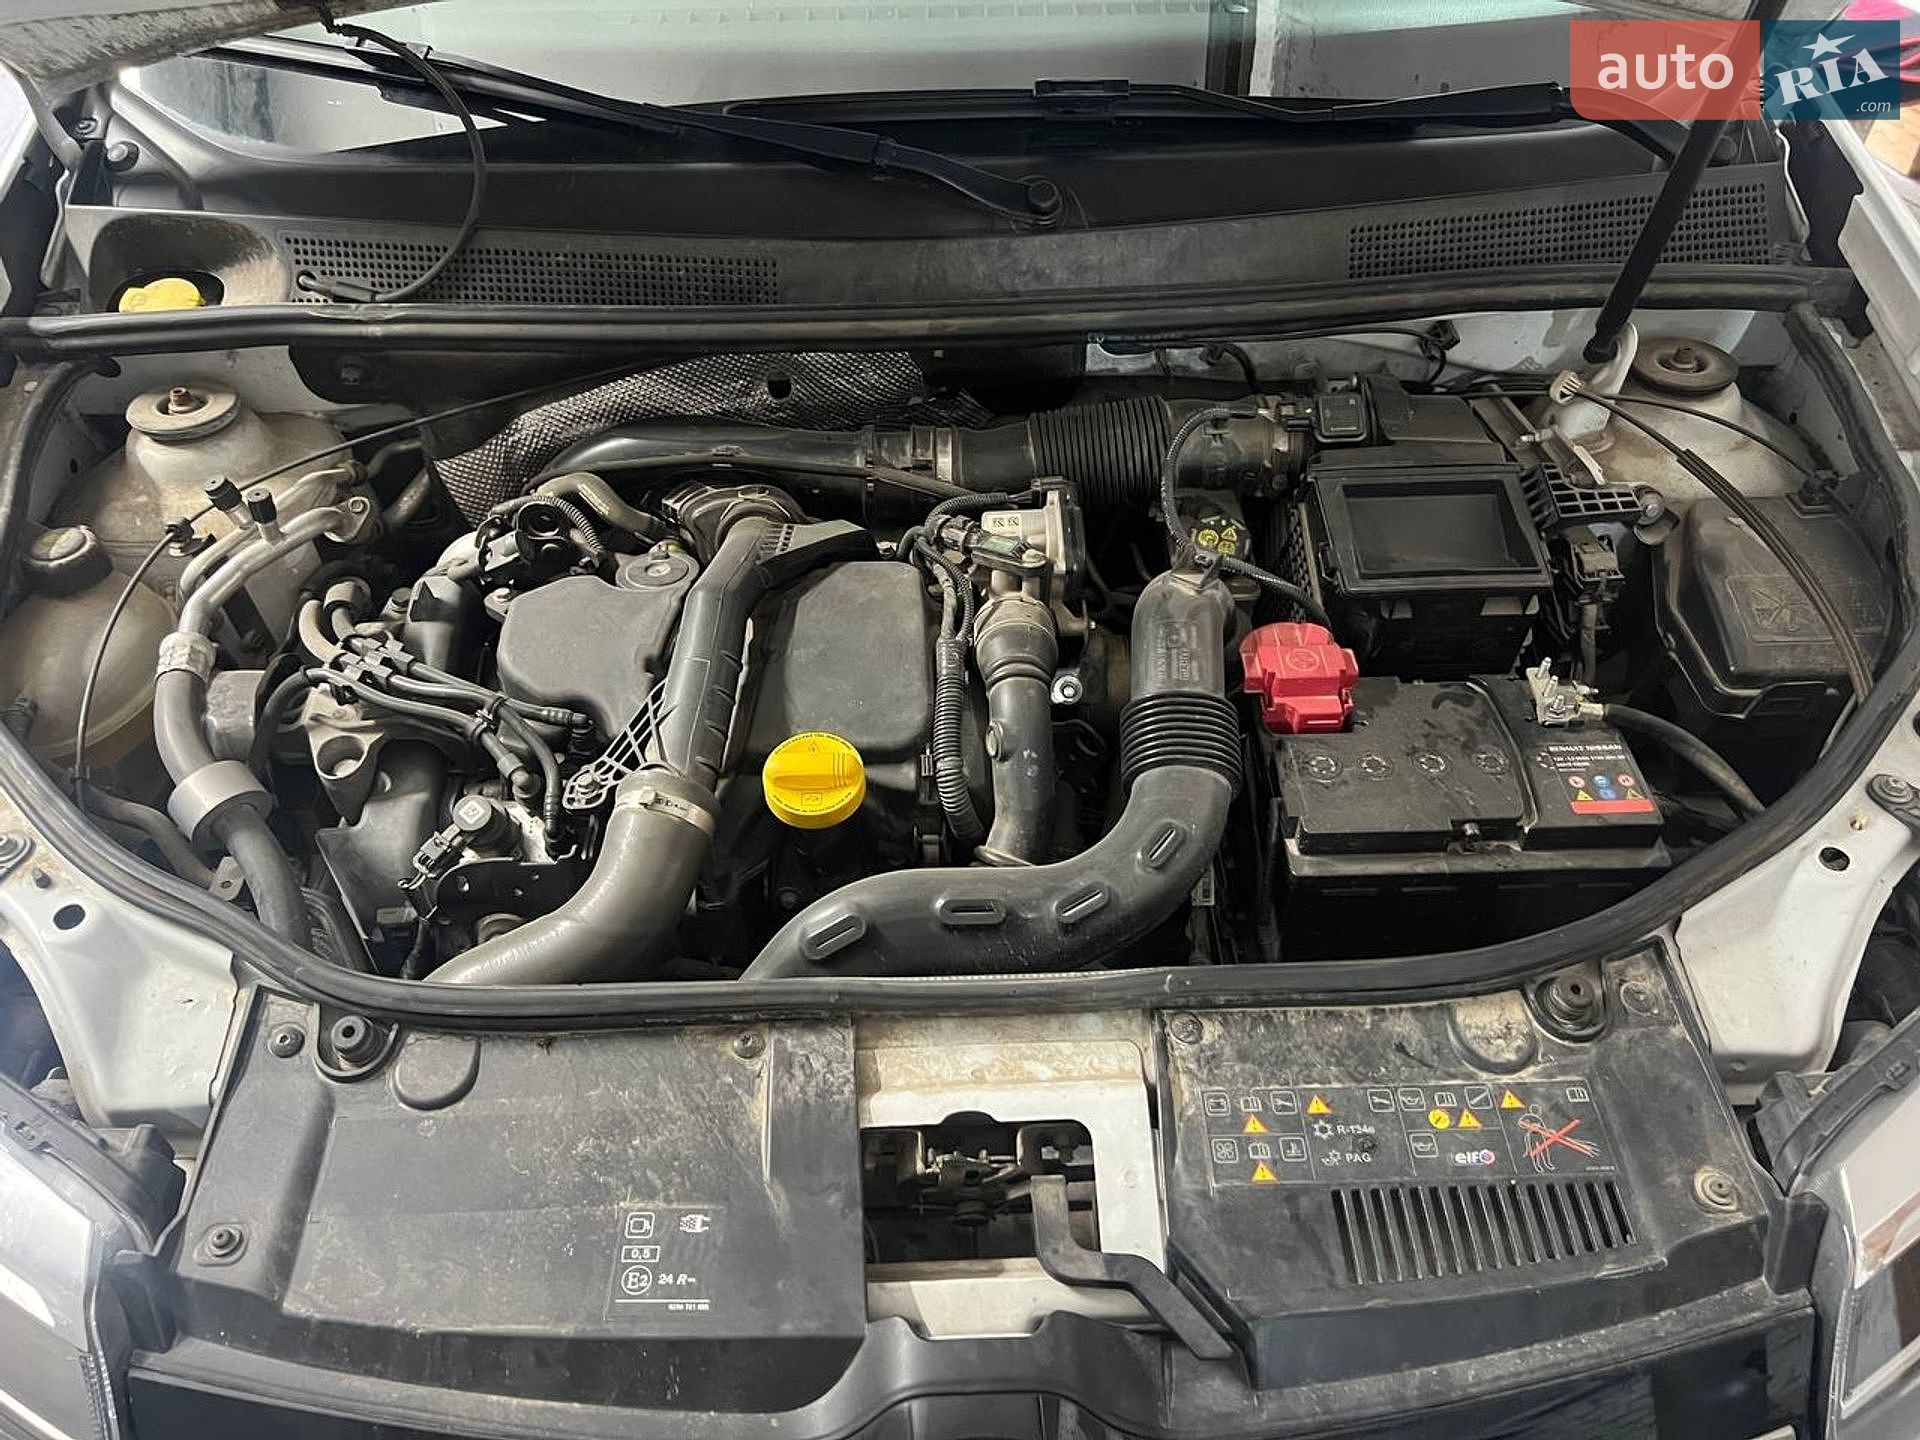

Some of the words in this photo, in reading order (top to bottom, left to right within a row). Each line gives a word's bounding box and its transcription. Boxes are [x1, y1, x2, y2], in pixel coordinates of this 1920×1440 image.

[1345, 1152, 1372, 1163] PAG
[631, 1248, 651, 1260] 0,5
[627, 1271, 648, 1290] E2
[658, 1273, 674, 1286] 24
